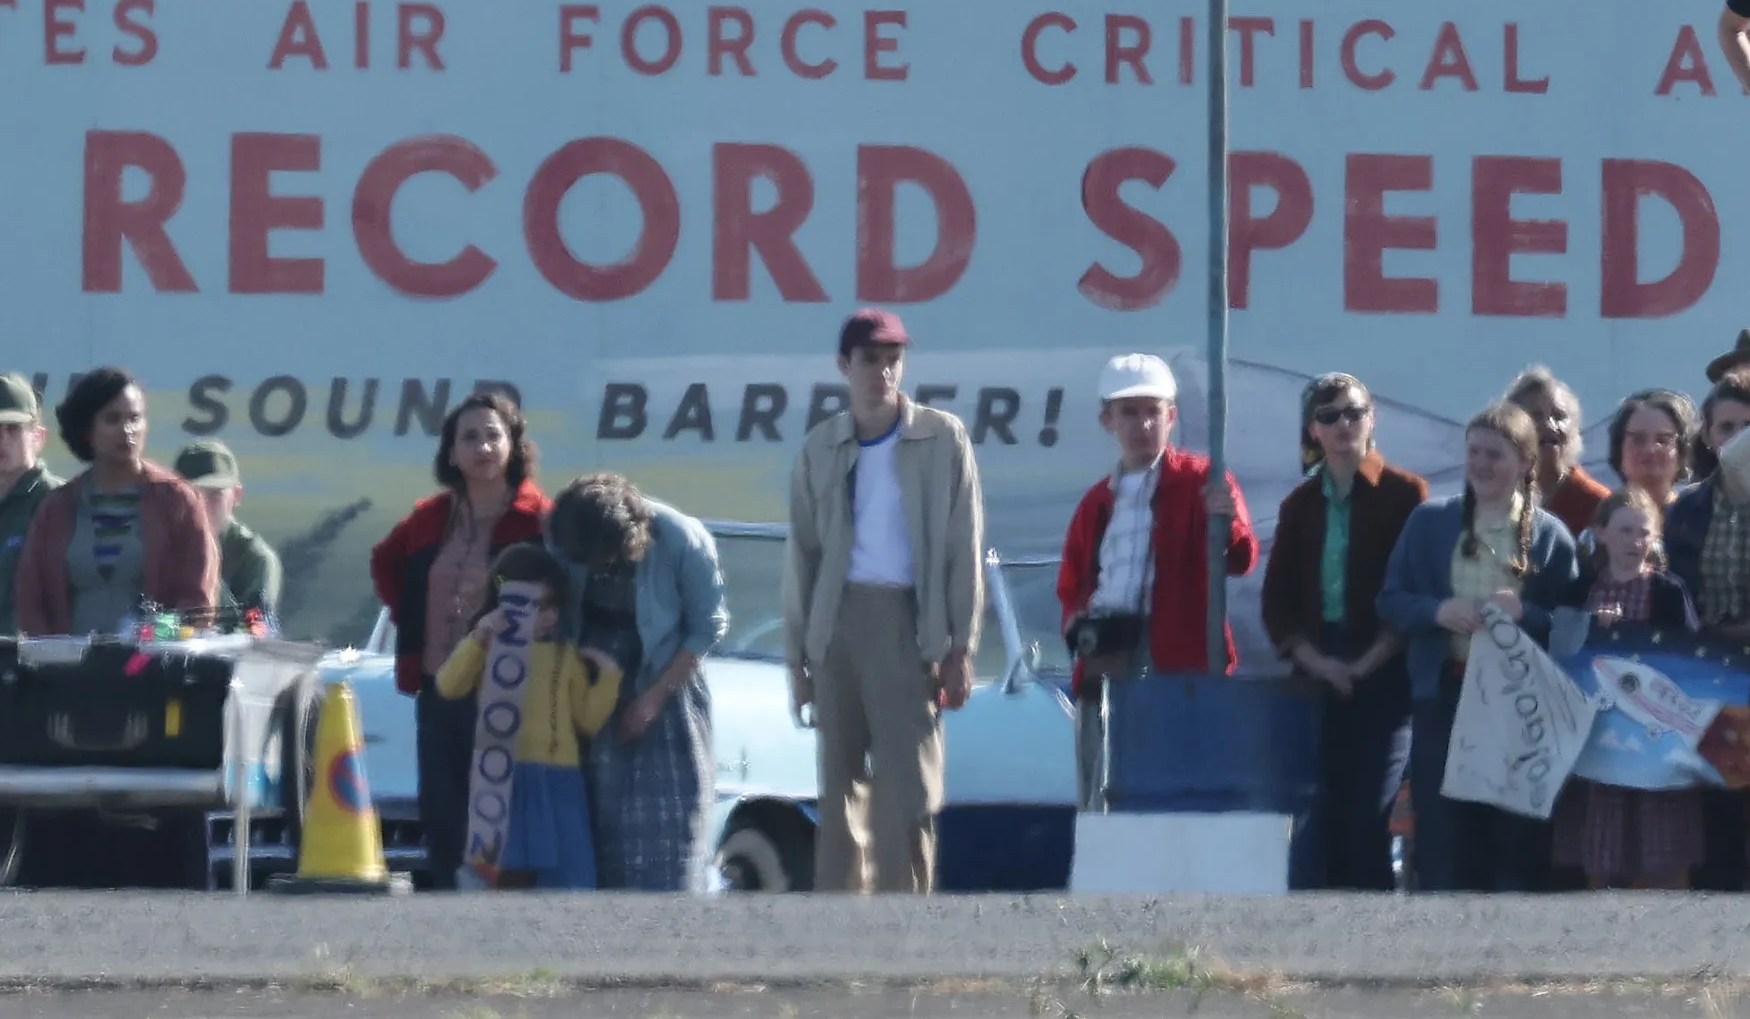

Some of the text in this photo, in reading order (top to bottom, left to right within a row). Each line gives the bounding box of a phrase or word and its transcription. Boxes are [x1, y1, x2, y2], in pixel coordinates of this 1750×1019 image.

[268, 0, 447, 70] AIR
[559, 4, 909, 81] FORCE
[1021, 12, 1551, 94] CRITICAL
[82, 130, 977, 308] RECORD
[1077, 146, 1721, 319] SPEED
